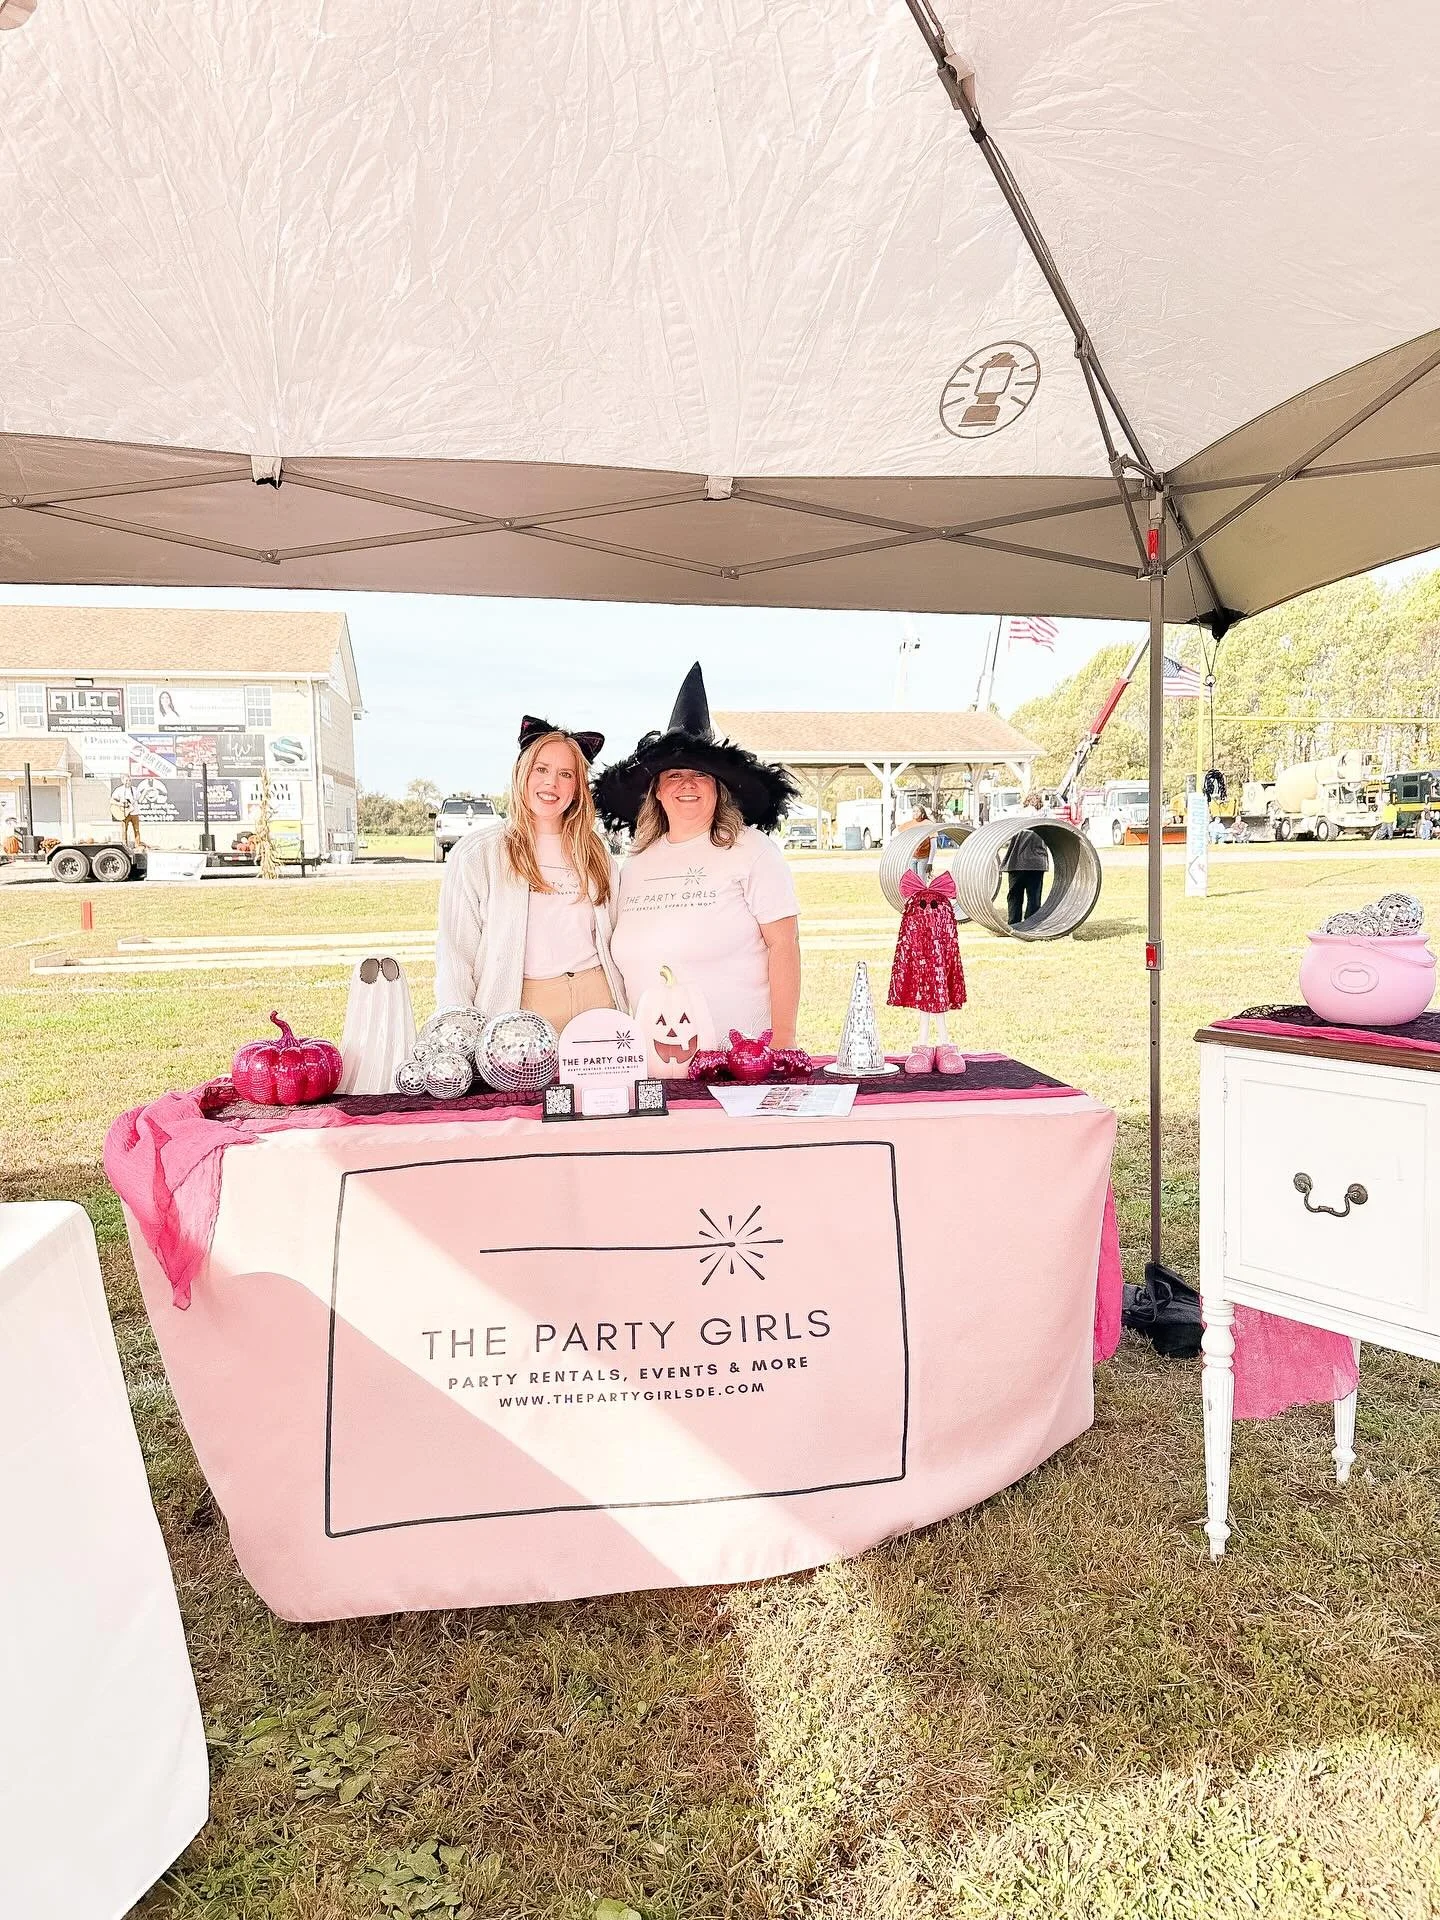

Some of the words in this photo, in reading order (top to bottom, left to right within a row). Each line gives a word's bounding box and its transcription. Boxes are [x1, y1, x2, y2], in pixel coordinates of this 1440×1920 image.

[625, 895, 640, 905] THE
[644, 893, 677, 903] PARTY
[681, 890, 717, 900] GIRLS
[562, 1058, 579, 1066] THE
[583, 1057, 613, 1065] PARTY
[616, 1054, 644, 1063] GIRLS
[421, 1326, 507, 1361] THE
[535, 1321, 676, 1354] PARTY
[700, 1309, 831, 1346] GIRLS
[448, 1373, 518, 1390] PARTY
[529, 1368, 629, 1384] RENTALS,
[639, 1363, 718, 1380] EVENTS
[729, 1361, 741, 1374] &
[751, 1355, 809, 1372] MORE
[498, 1382, 766, 1408] WWW.THEPARTYGIRLSDE.COM
